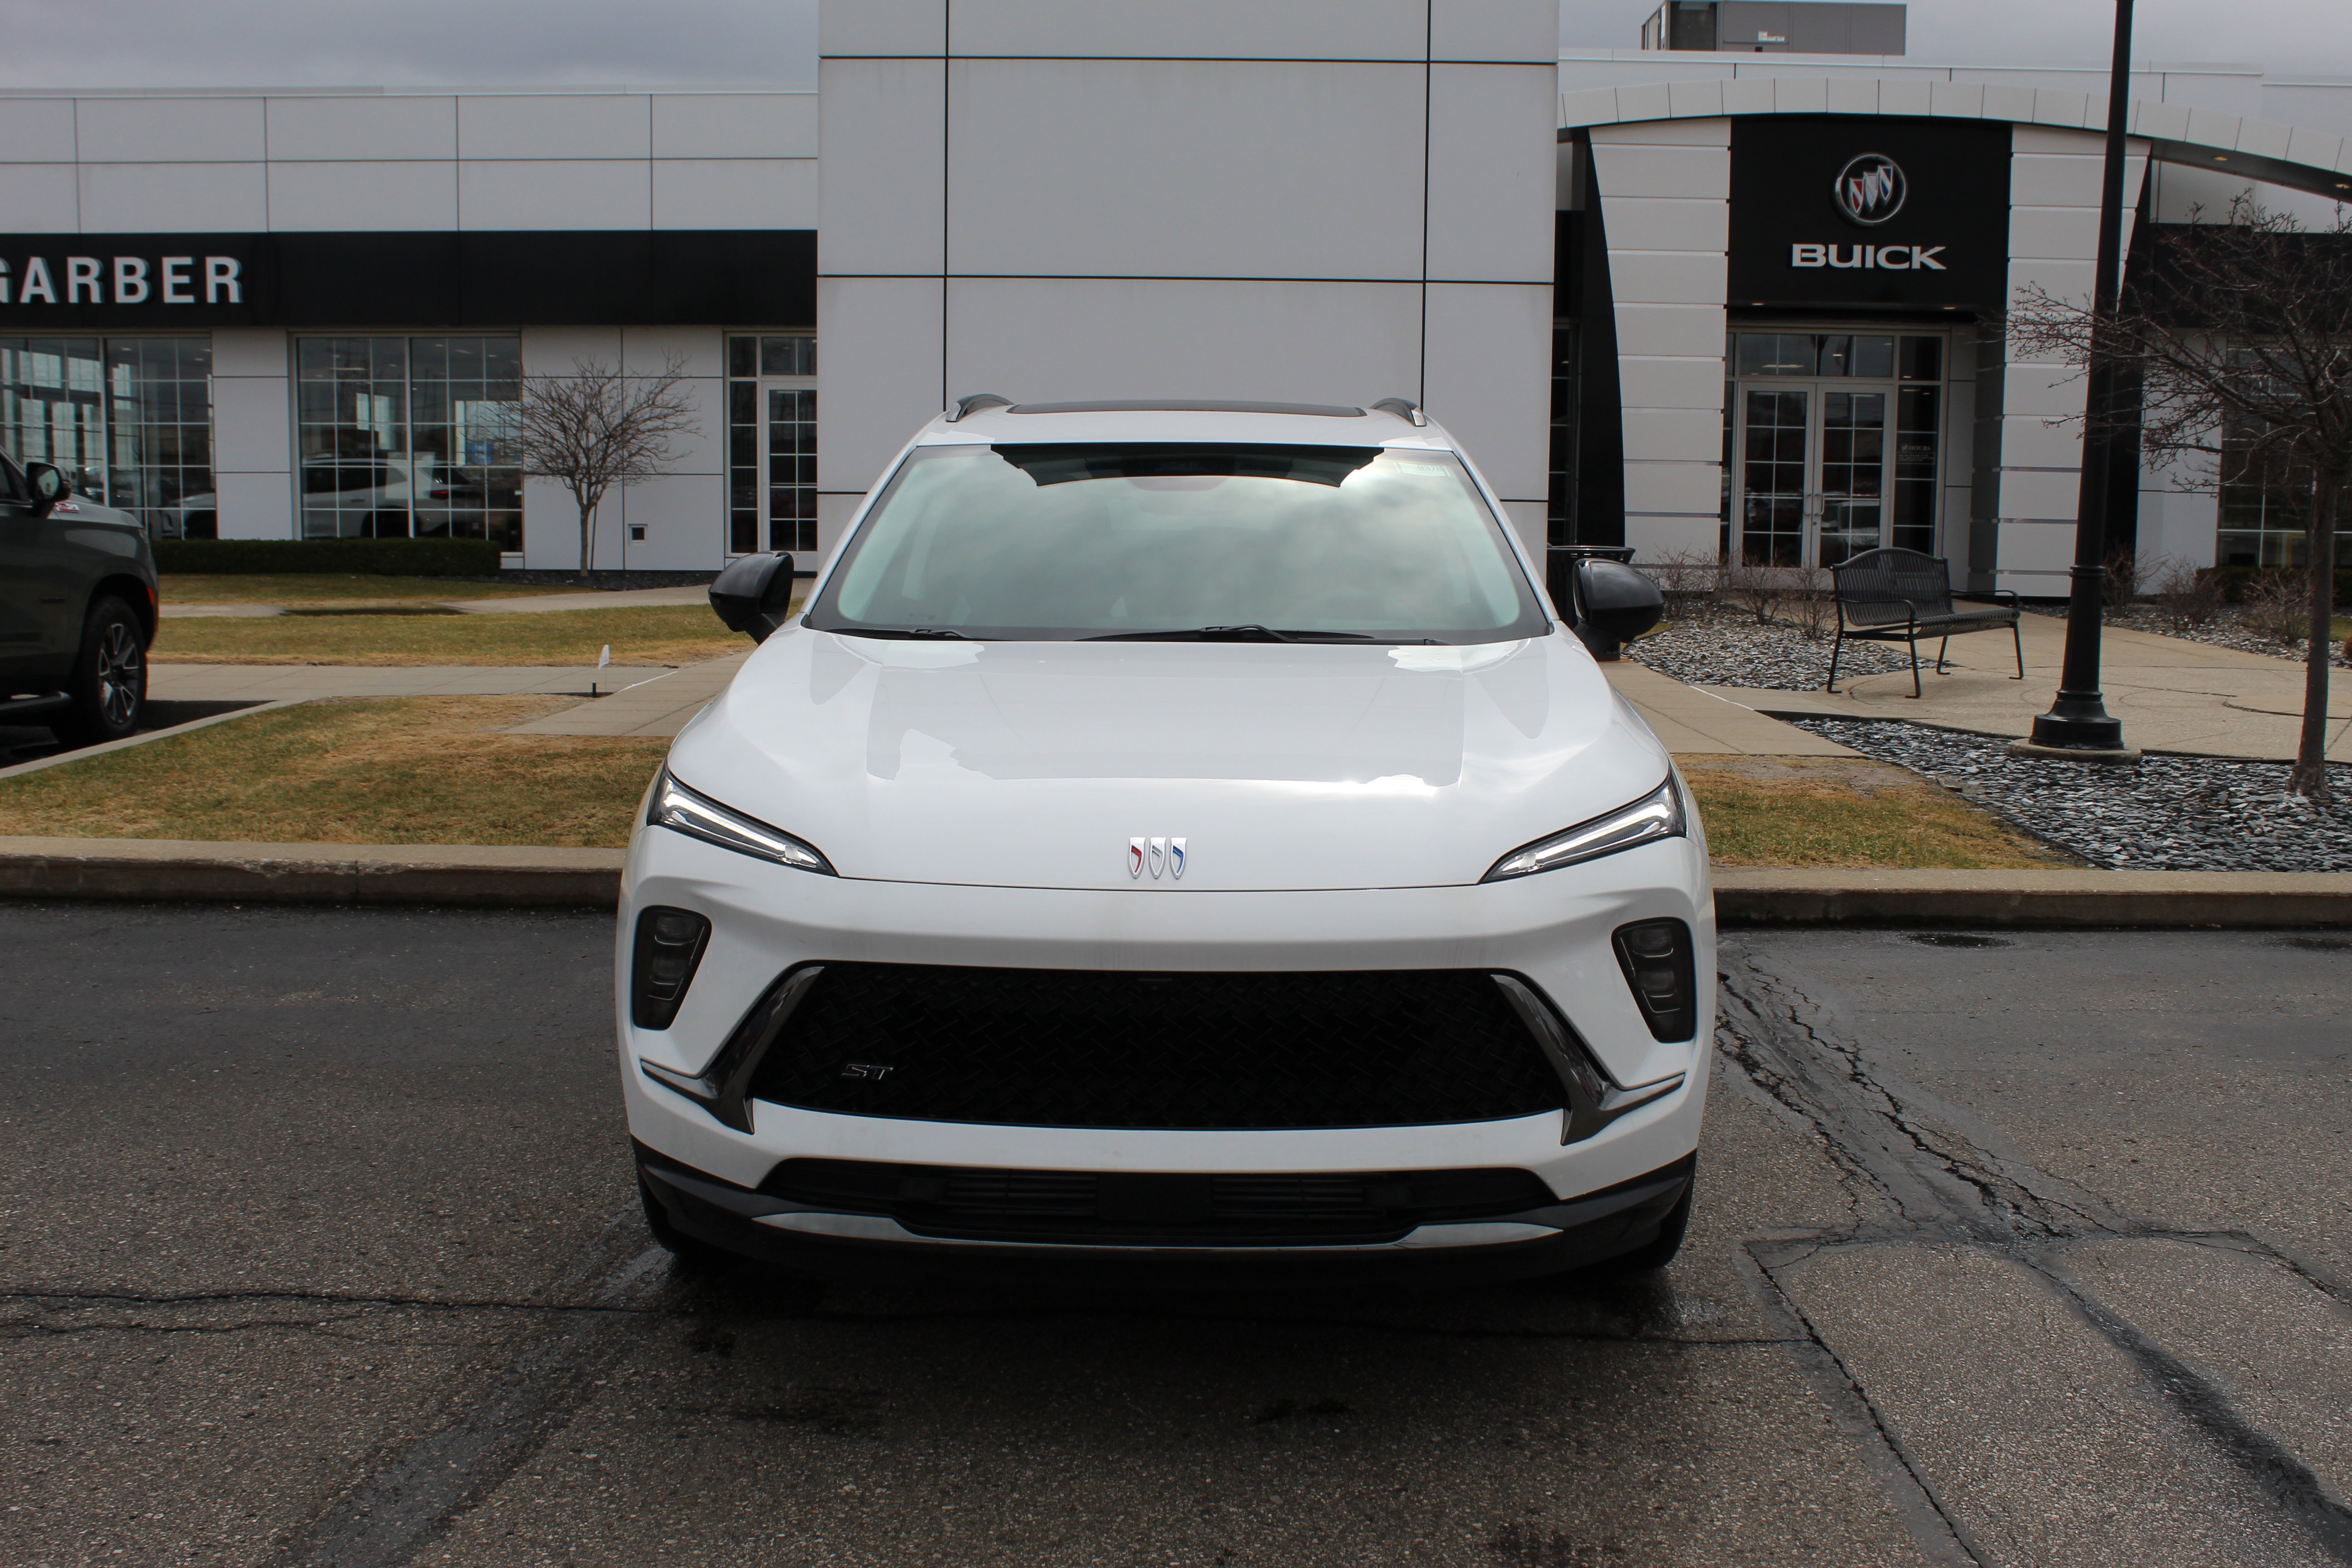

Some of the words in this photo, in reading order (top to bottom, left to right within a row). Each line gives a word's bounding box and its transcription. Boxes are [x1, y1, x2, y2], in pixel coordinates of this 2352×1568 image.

[1791, 243, 1947, 270] BUICK
[0, 256, 243, 304] ARBER
[841, 1063, 894, 1080] ST
